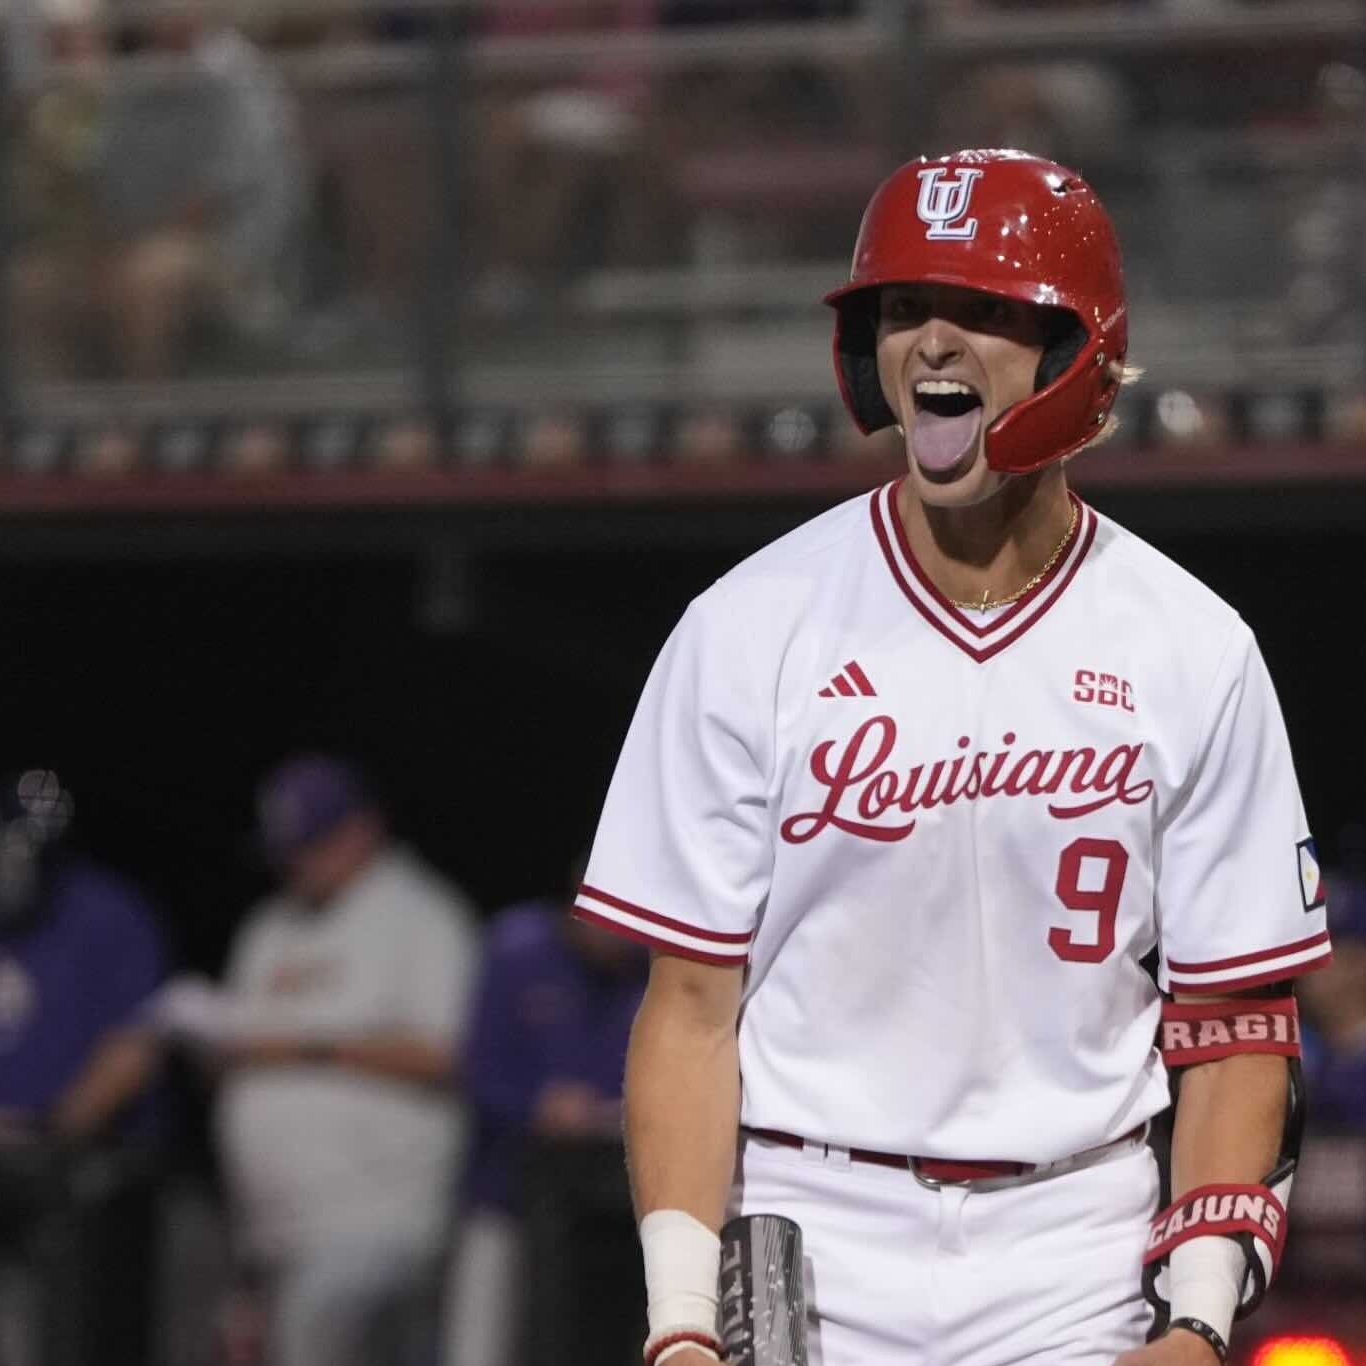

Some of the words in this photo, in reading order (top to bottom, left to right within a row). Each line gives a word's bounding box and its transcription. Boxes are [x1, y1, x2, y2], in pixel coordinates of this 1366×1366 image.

[917, 167, 984, 240] UL
[1074, 669, 1135, 713] SBC
[781, 714, 1154, 844] Louisiana
[1048, 837, 1129, 964] 9
[1163, 1013, 1300, 1050] RAGI
[1147, 1194, 1280, 1250] CAJUNS
